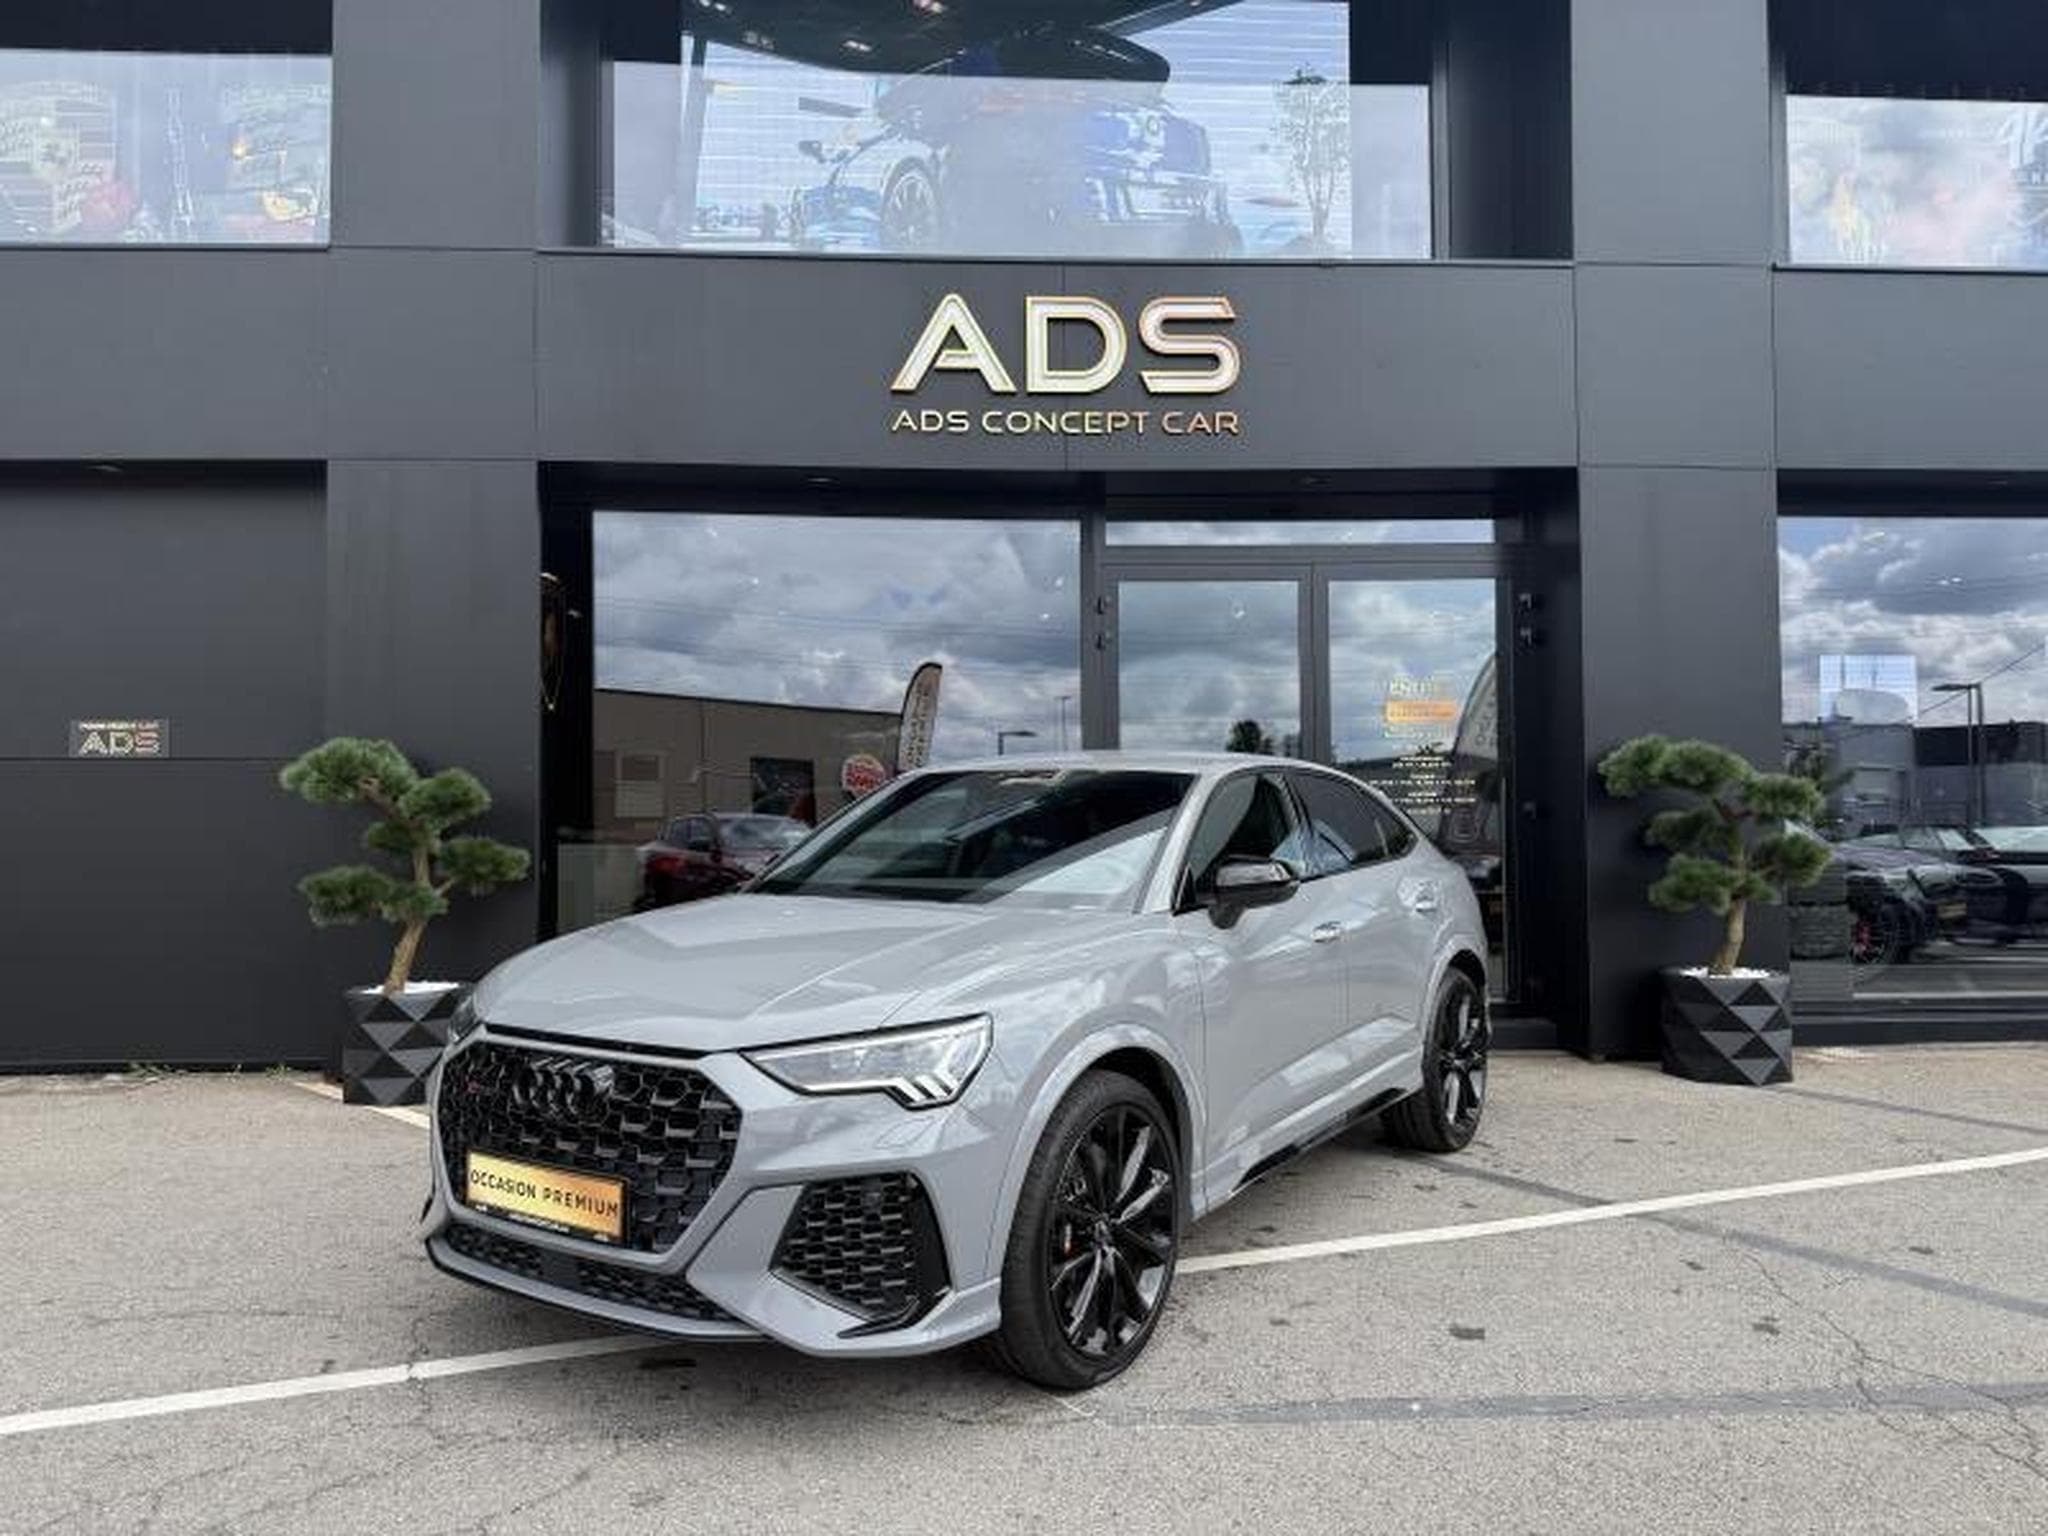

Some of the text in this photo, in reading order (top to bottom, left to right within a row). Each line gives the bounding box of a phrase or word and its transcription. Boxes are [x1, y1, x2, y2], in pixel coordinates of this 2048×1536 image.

[891, 293, 1240, 393] ADS
[891, 410, 1240, 434] ADS CONCEPT CAR
[80, 731, 160, 755] ADS
[470, 1169, 619, 1218] OCCASION PREMIUM
